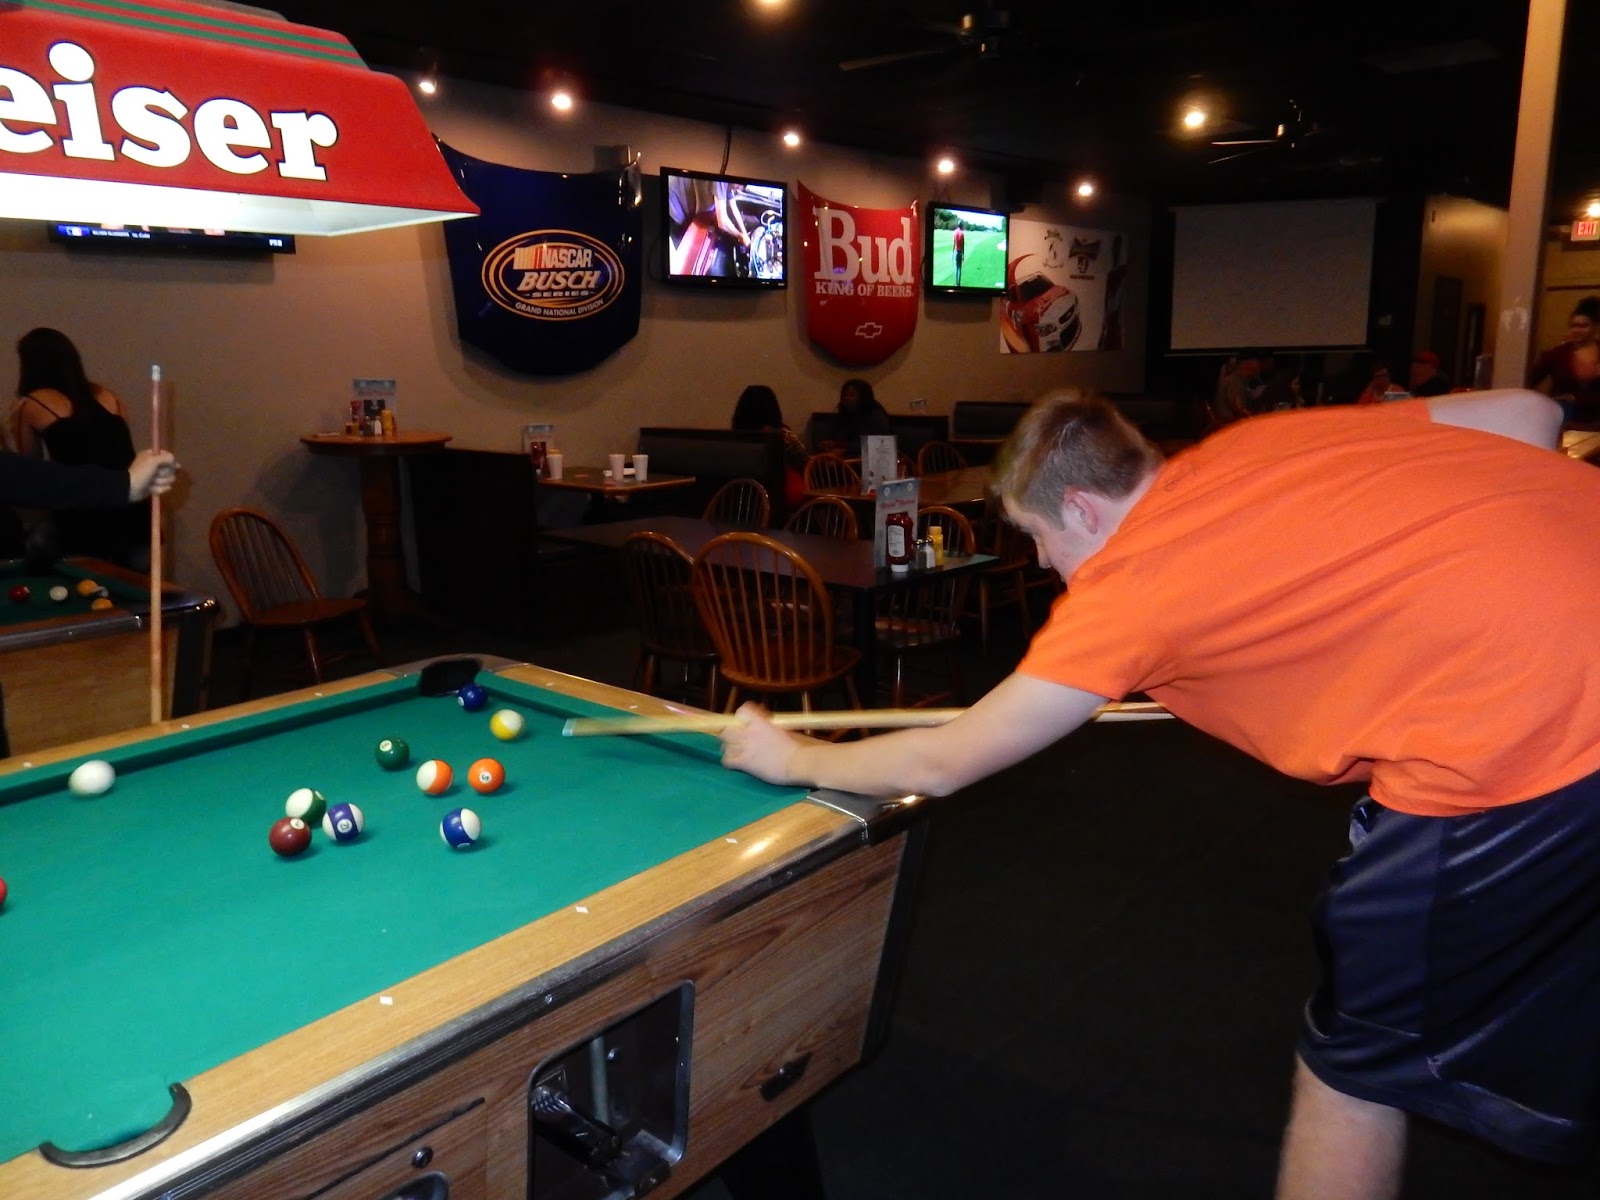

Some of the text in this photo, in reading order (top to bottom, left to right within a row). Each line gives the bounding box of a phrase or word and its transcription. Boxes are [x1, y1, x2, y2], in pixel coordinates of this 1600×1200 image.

[0, 41, 338, 181] eiser
[1577, 221, 1599, 236] EXIT
[813, 206, 914, 285] Bud
[541, 247, 593, 269] NASCAR
[517, 270, 601, 292] BUSCH
[815, 281, 854, 296] KING
[857, 283, 875, 297] OF
[515, 298, 604, 317] GRAND NATIONAL DIVISION
